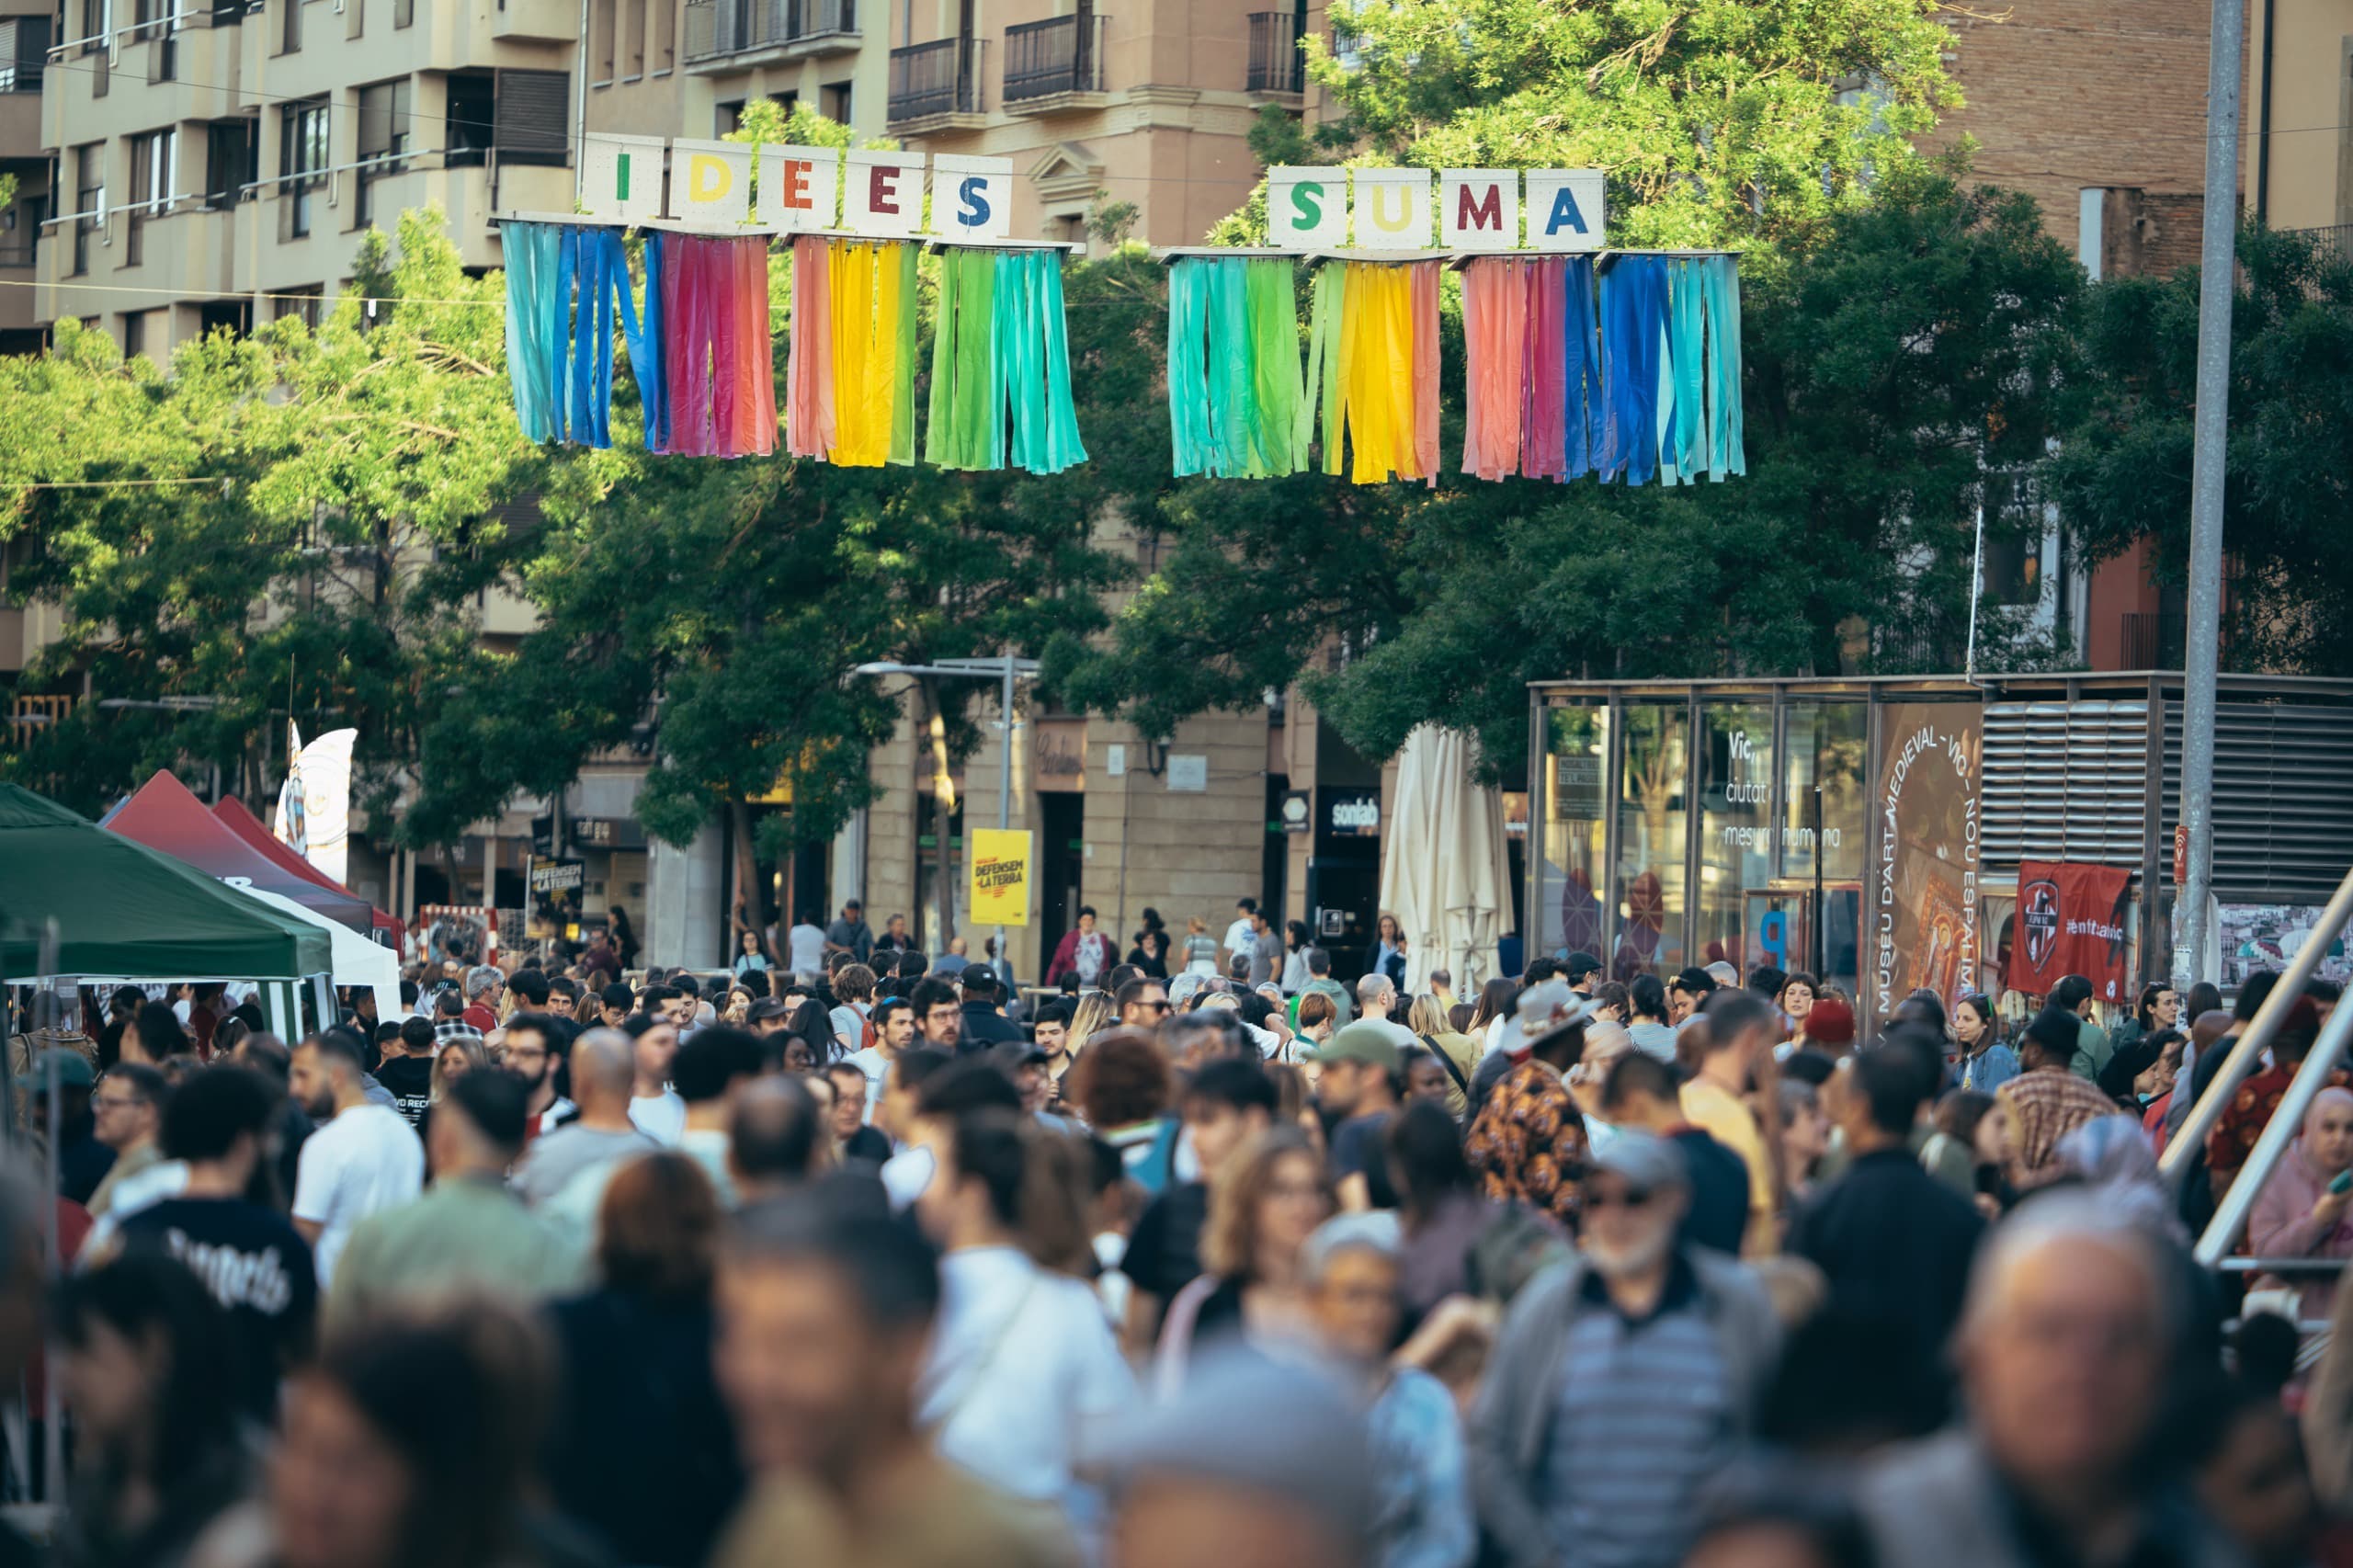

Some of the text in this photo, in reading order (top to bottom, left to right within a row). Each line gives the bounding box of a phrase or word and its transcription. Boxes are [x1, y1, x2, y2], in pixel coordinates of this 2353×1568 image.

[617, 153, 992, 227] IDEES
[1290, 180, 1589, 235] SUMA
[1728, 731, 1756, 763] Vic,
[1885, 724, 1938, 818] MEDIEVAL
[1948, 734, 1967, 777] VIC
[1333, 798, 1378, 826] sonlab
[1726, 776, 1767, 803] ciutat
[1782, 815, 1840, 847] humna
[1964, 797, 1976, 862] NOU
[975, 859, 1024, 877] DEFENSEM
[979, 871, 1023, 888] LA TERRA
[1881, 826, 1894, 905] D'ART
[1961, 870, 1975, 949] ESPAI
[1878, 913, 1893, 1014] MUSEU
